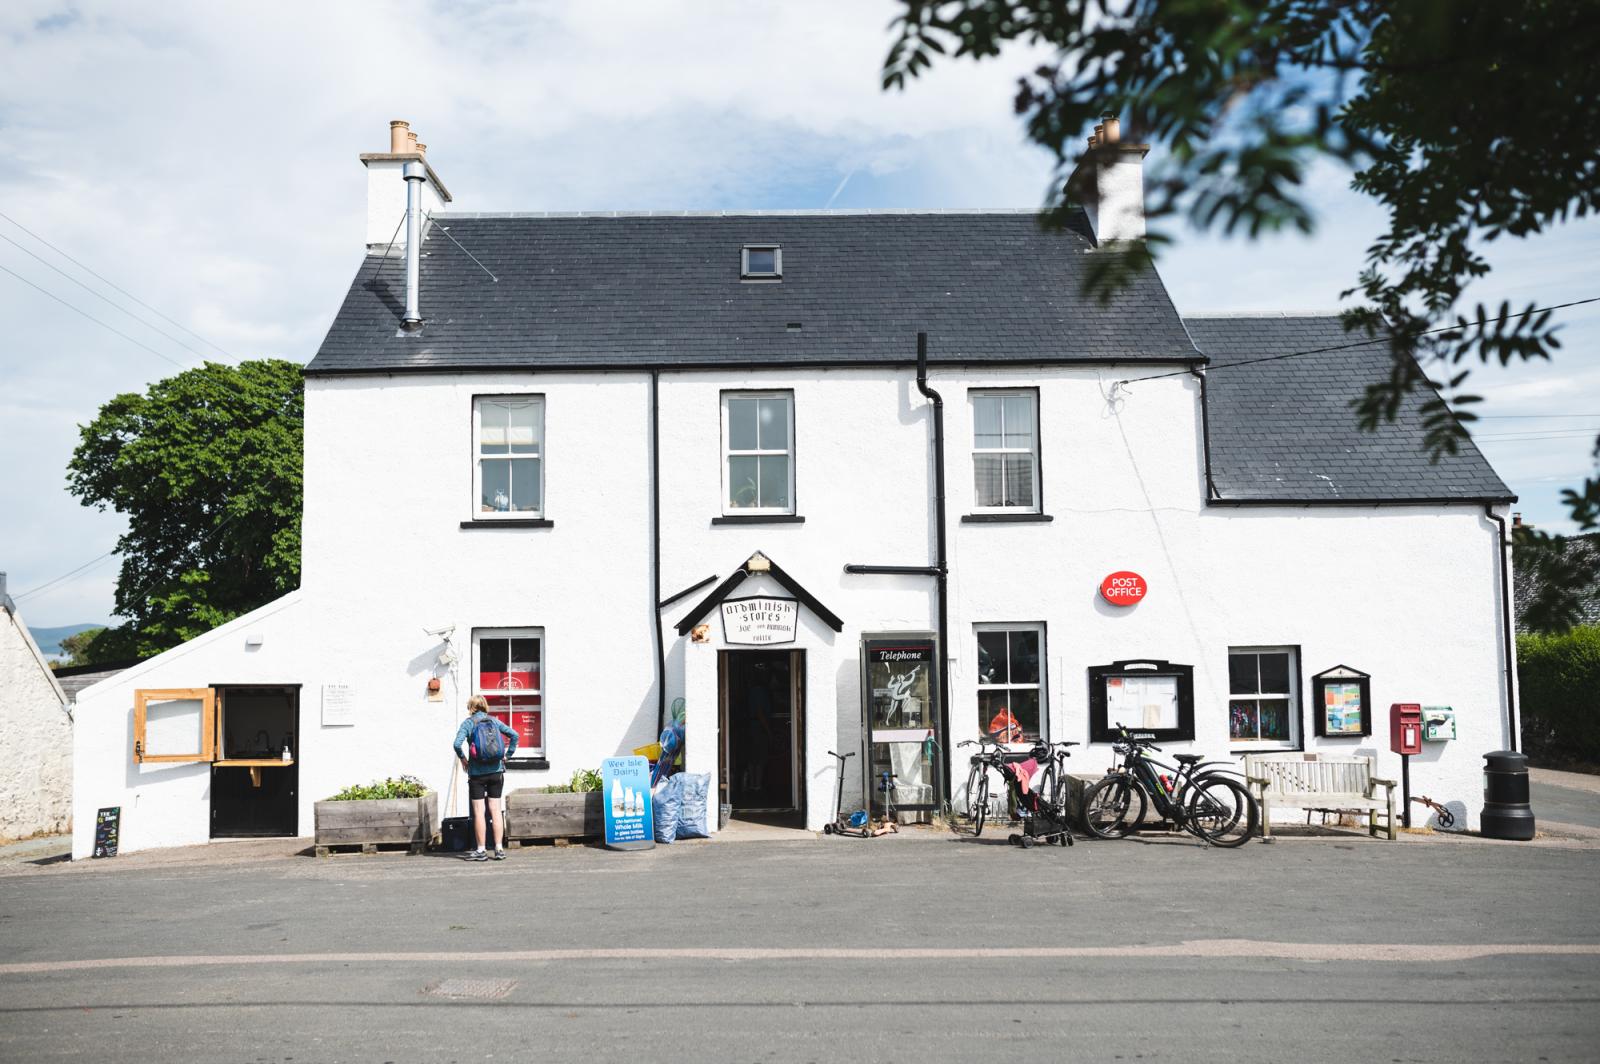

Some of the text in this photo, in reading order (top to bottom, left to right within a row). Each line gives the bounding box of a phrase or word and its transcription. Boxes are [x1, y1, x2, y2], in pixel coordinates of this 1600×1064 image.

[1112, 578, 1138, 587] POST
[1106, 587, 1142, 597] OFFICE
[880, 651, 922, 661] Telephone
[608, 760, 624, 768] Wee
[613, 768, 639, 777] Dairy
